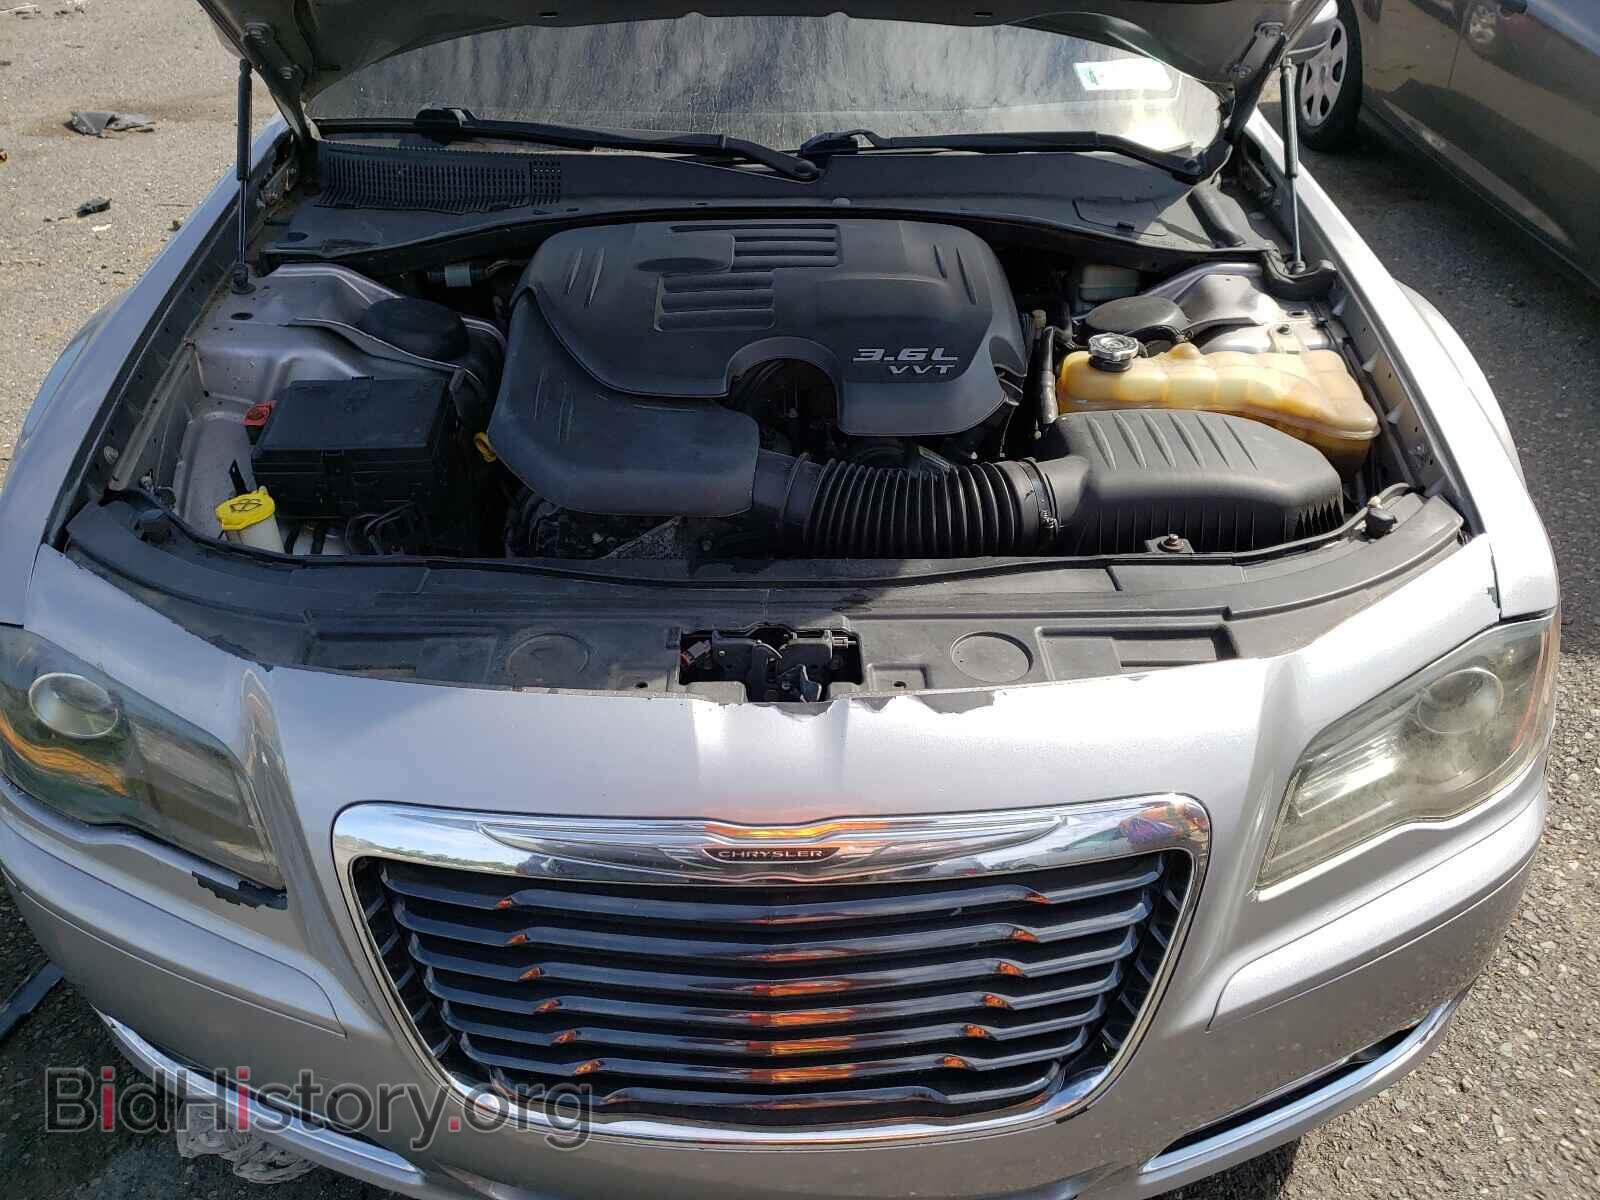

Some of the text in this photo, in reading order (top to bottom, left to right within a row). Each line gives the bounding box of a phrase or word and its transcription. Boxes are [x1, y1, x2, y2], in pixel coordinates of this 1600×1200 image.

[853, 347, 958, 361] 3.6L
[888, 364, 956, 374] VVT
[717, 849, 824, 858] CHRYSLER
